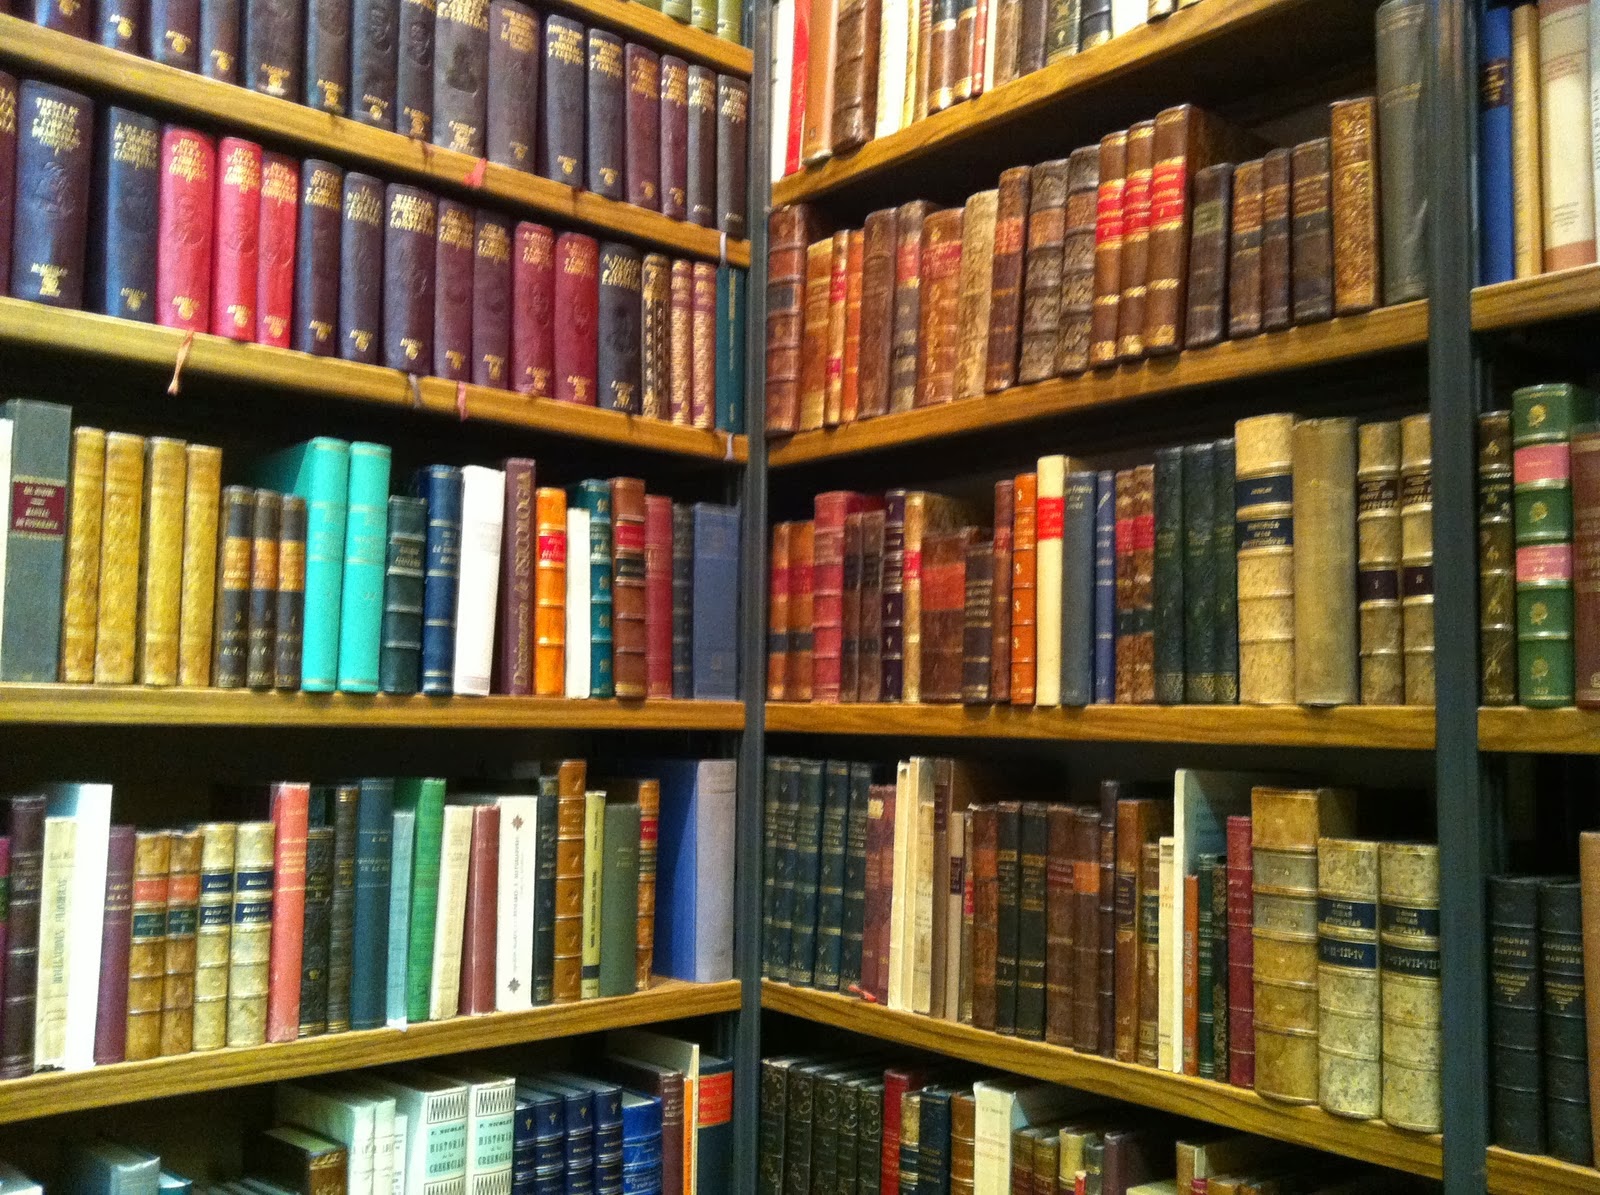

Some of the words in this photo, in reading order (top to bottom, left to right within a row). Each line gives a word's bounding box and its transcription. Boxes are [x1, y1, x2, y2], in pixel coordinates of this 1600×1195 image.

[430, 1137, 465, 1154] HISTORIA
[479, 1131, 512, 1146] HISTORIA
[429, 1158, 465, 1174] CREENCIAS
[478, 1150, 512, 1166] CREENCIAS
